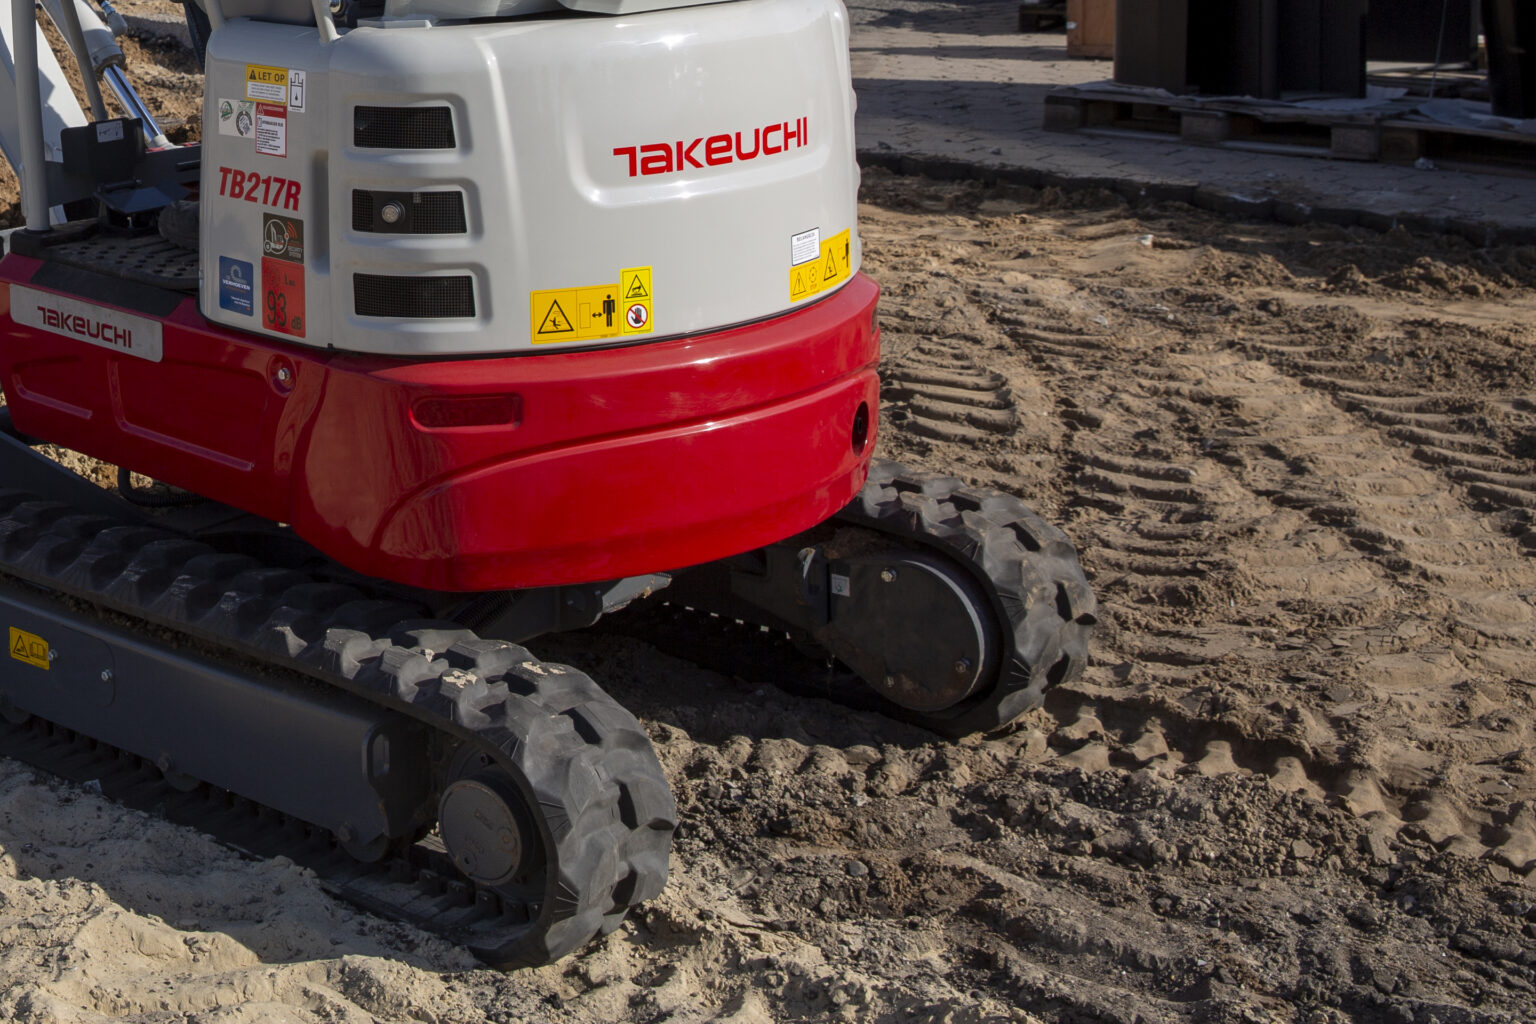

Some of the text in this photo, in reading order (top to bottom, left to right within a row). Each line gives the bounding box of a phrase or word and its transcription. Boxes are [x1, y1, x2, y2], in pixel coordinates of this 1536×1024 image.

[258, 71, 285, 83] LET OP
[613, 116, 808, 177] TAKEUCHI
[219, 166, 302, 211] TB217R
[222, 278, 251, 291] VERHOEVEN
[37, 305, 132, 348] TAKEUCHI
[267, 289, 287, 327] 93
[291, 316, 302, 330] dB
